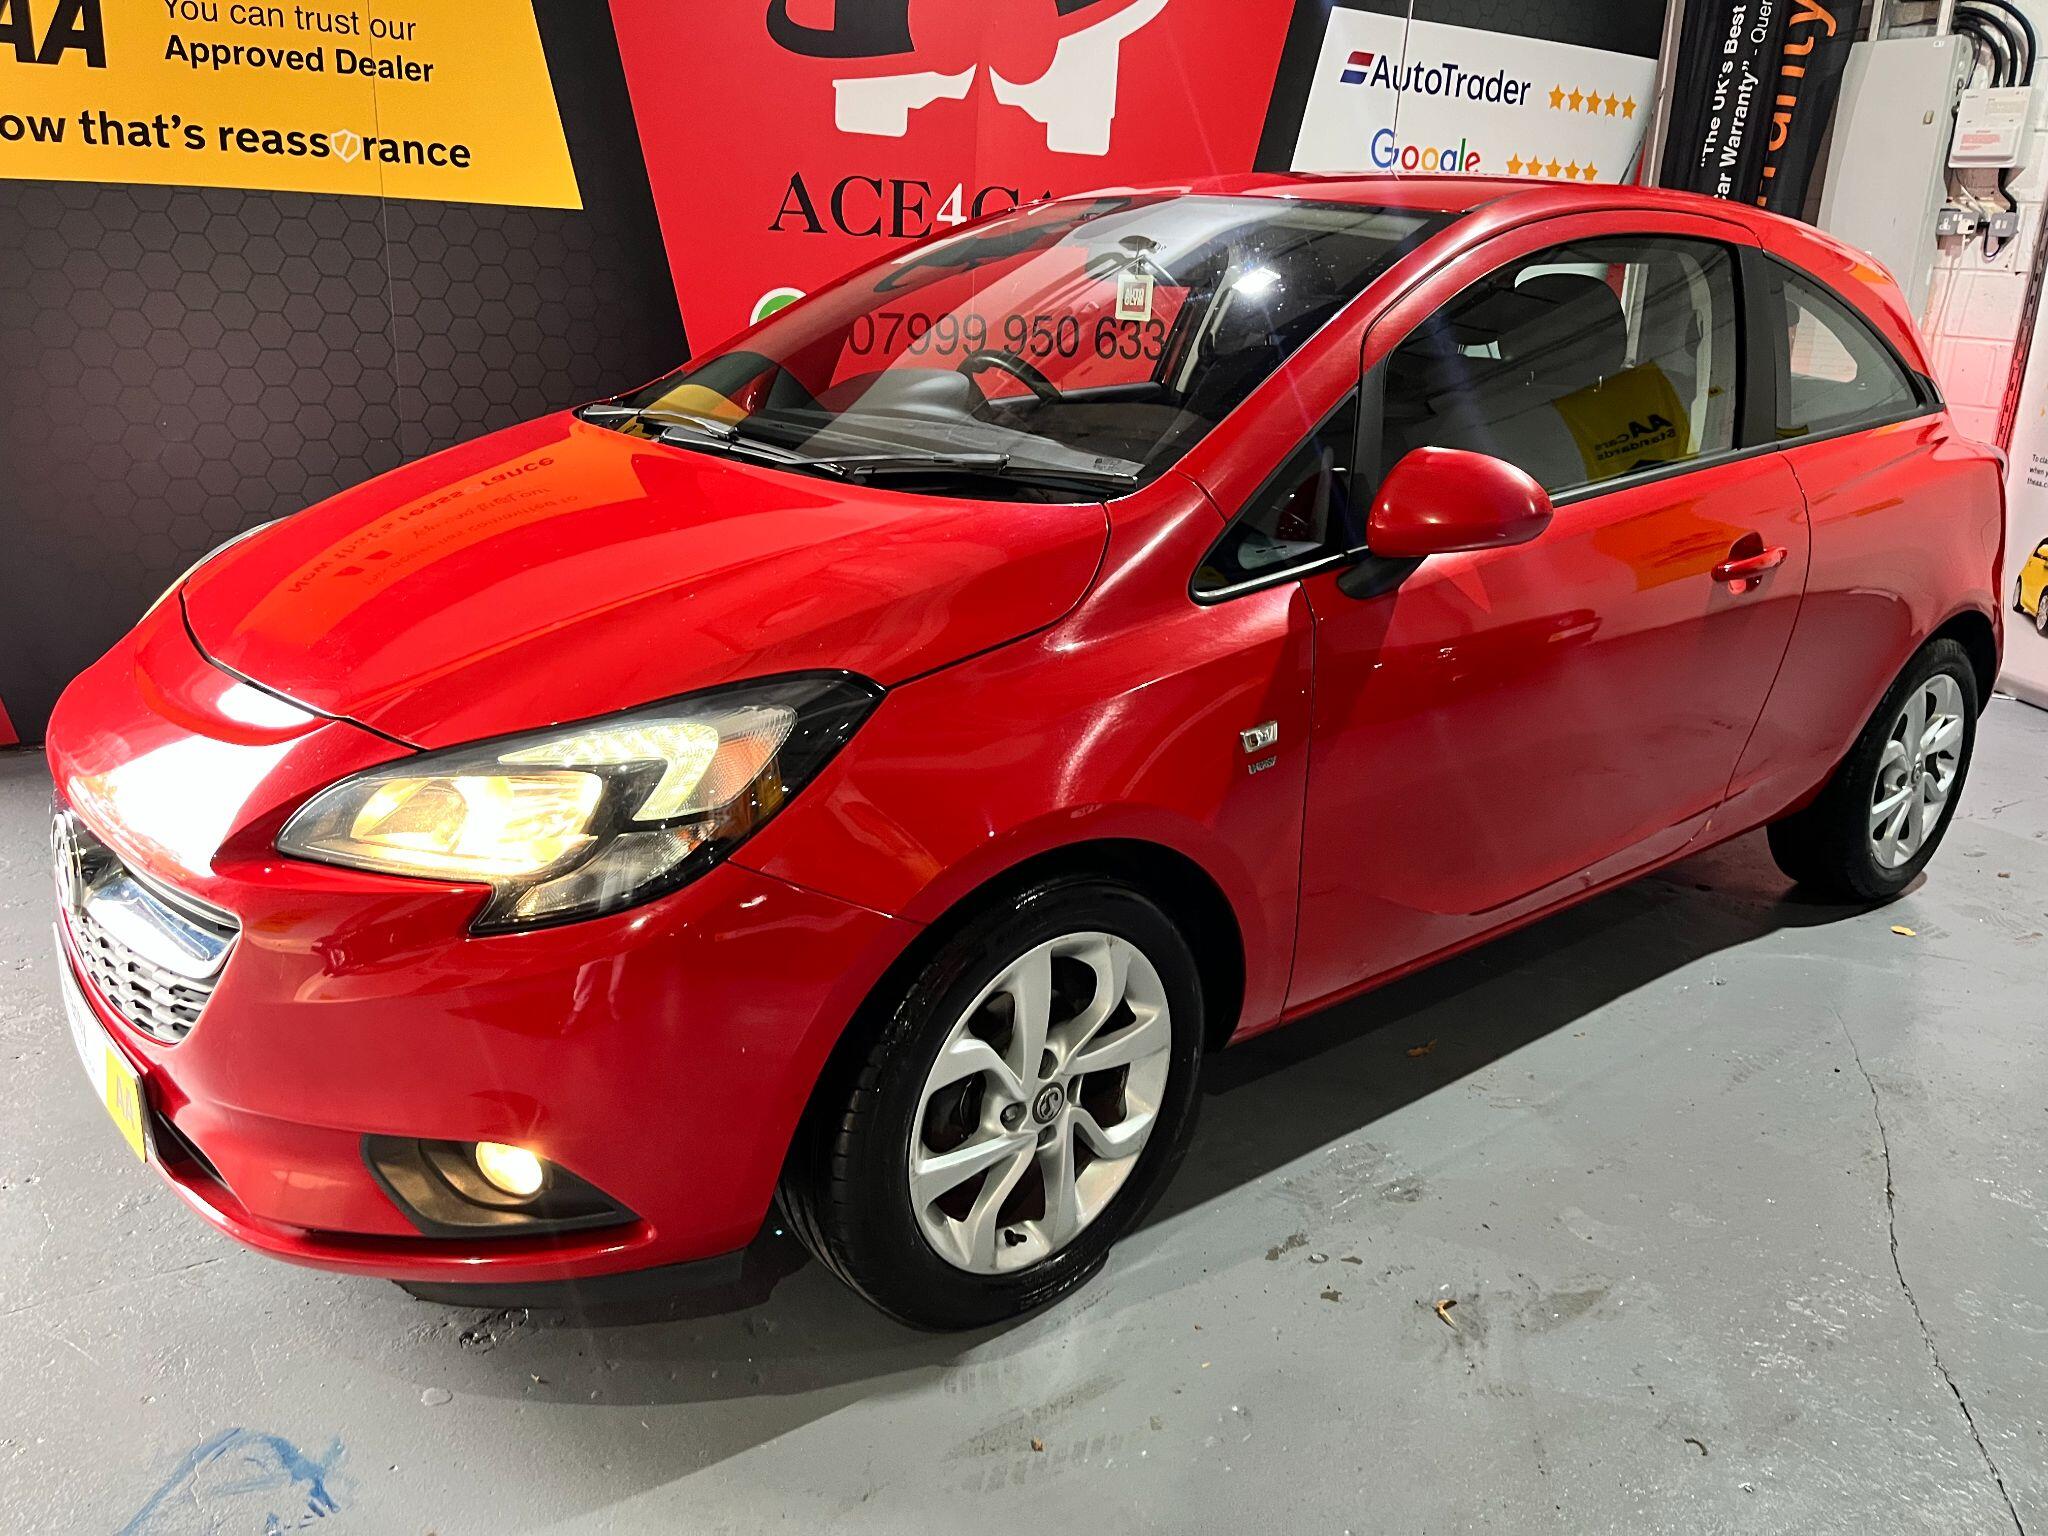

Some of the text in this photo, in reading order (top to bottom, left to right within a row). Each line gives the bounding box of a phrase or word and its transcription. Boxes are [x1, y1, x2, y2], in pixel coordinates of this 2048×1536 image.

[165, 0, 417, 41] You can trust our
[165, 34, 434, 83] Approved Dealer
[1370, 55, 1532, 106] AutoTrader
[1700, 5, 1747, 168] “The UK’s Best
[1719, 60, 1760, 168] Warranty”
[79, 110, 206, 150] that’s
[219, 124, 472, 169] reassrance
[1371, 128, 1481, 172] Google
[768, 171, 1052, 239] ACE4C
[1713, 172, 1732, 200] ar
[850, 312, 1167, 360] 07999 950 633
